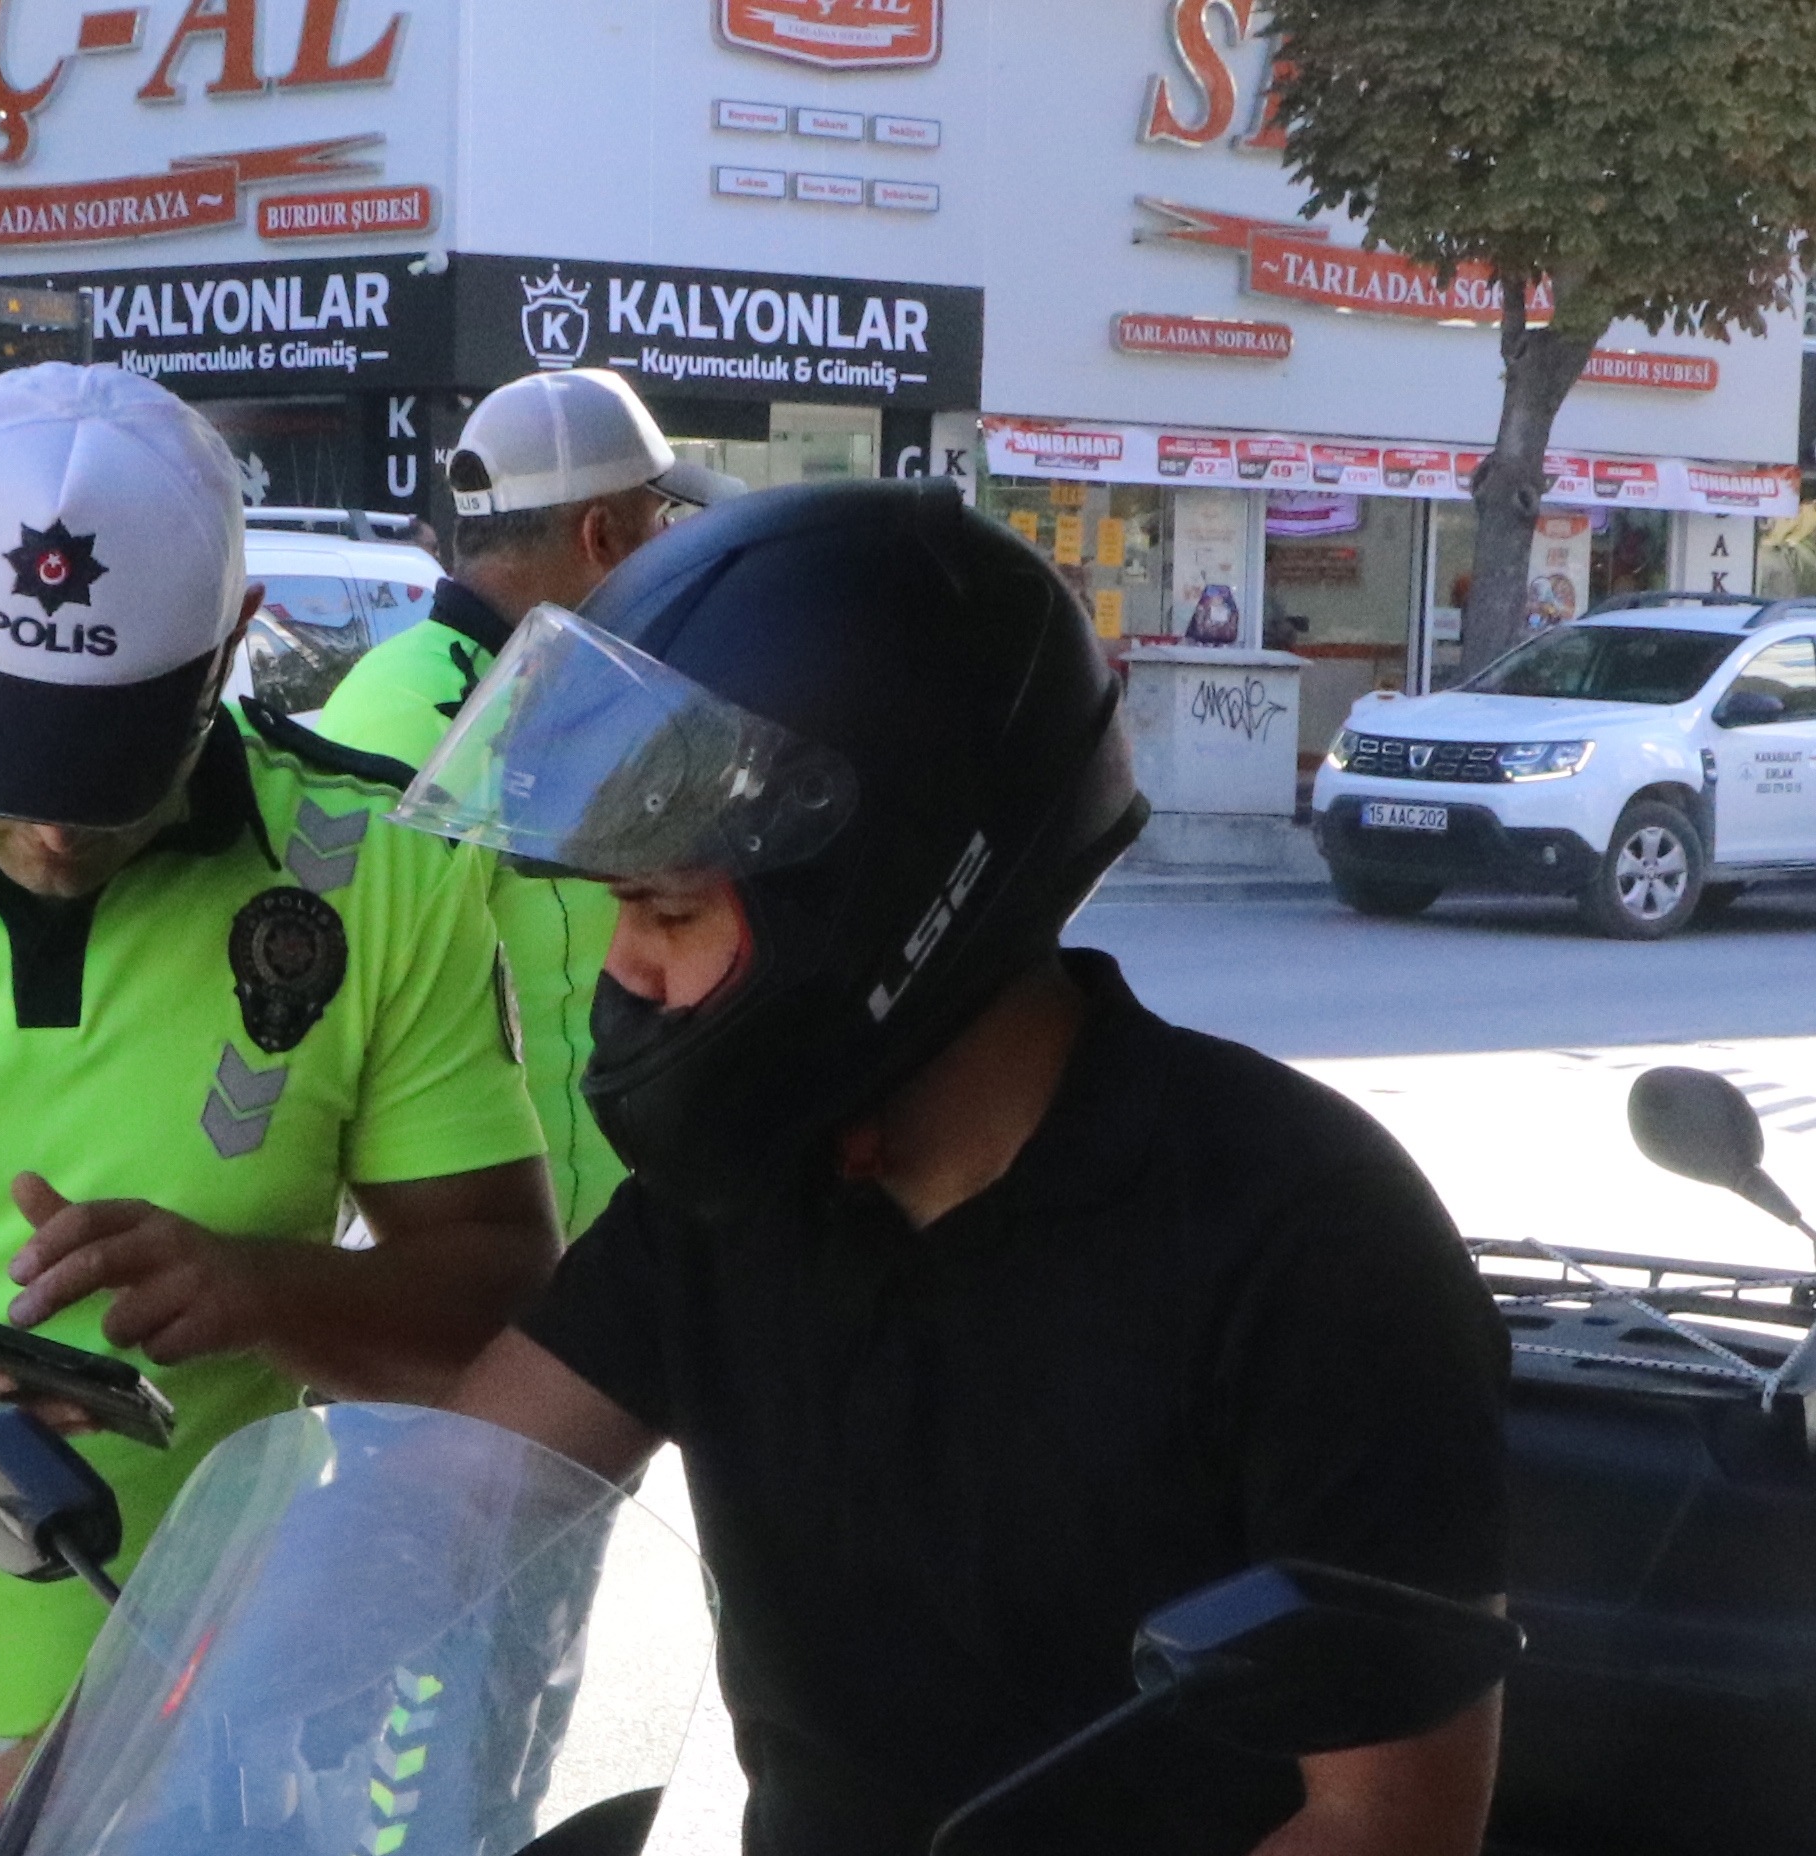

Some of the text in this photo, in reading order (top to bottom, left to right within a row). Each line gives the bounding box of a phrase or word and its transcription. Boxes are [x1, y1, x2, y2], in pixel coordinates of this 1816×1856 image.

[73, 190, 190, 231] SOFRAYA
[266, 191, 422, 231] BURDUR ŞUBESİ
[1282, 250, 1447, 307] TARLADAN
[92, 271, 390, 340] KALYONLAR
[608, 278, 929, 353] KALYONLAR
[1122, 322, 1288, 353] TARLADAN SOFRAYA
[121, 341, 358, 380] Kuyumculuk & Gümüş
[641, 346, 898, 395] Kuyumculuk & Gümüş
[1652, 360, 1711, 386] ŞUBESİ
[1012, 430, 1123, 460] SONBAHAR
[1370, 805, 1446, 828] 15 AAC 202
[867, 829, 992, 1023] LS2
